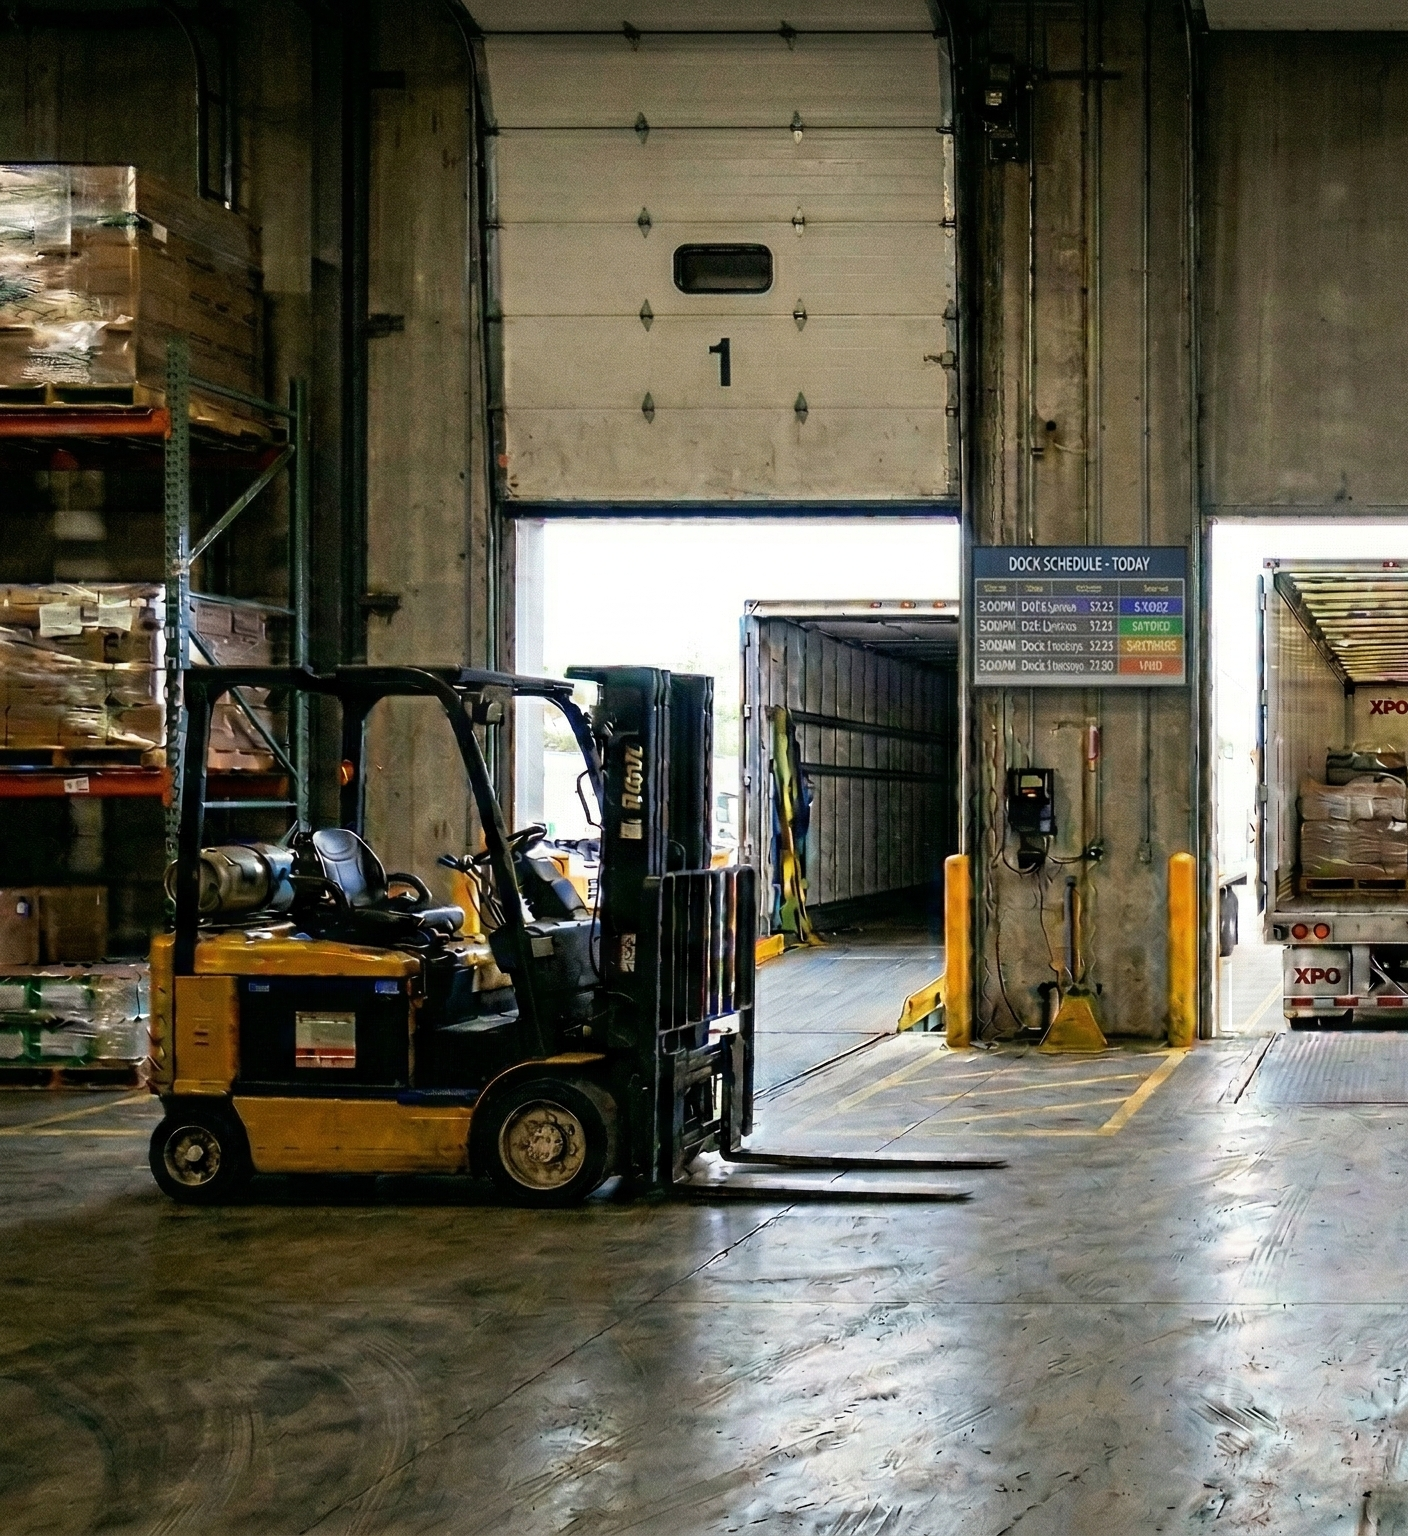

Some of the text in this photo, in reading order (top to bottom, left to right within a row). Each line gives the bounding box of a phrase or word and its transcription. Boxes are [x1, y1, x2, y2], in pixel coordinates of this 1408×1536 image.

[709, 338, 731, 386] 1
[1009, 557, 1041, 571] DOCK
[1043, 557, 1102, 571] SCHEDULE
[1112, 557, 1150, 571] TODAY
[1294, 968, 1341, 984] XPO
